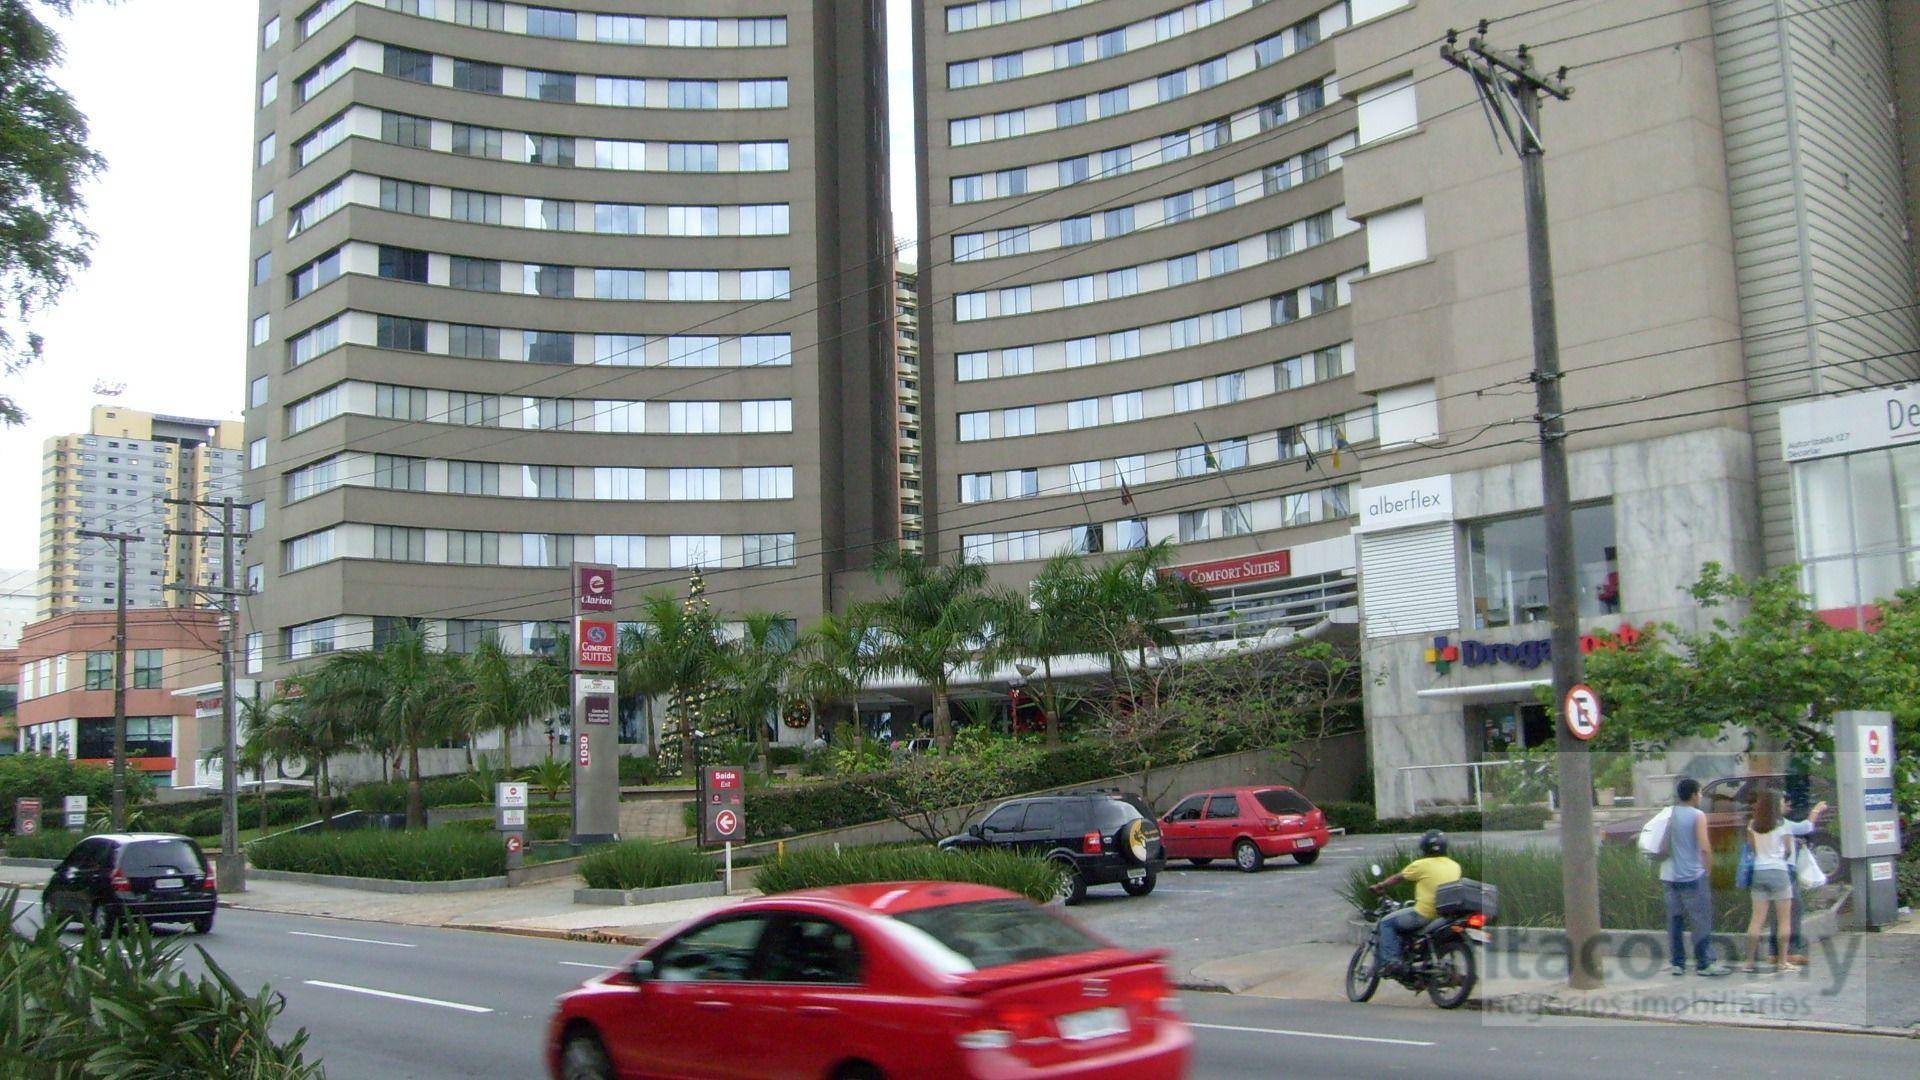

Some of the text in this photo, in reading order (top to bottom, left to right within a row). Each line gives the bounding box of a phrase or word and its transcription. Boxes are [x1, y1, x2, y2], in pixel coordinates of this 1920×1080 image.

[1369, 490, 1441, 516] alberflex
[1189, 560, 1280, 585] COMFORT SUITES
[581, 595, 612, 605] Clarion
[581, 641, 612, 653] COMFORT
[582, 652, 612, 662] SUITES
[580, 736, 588, 763] 1030
